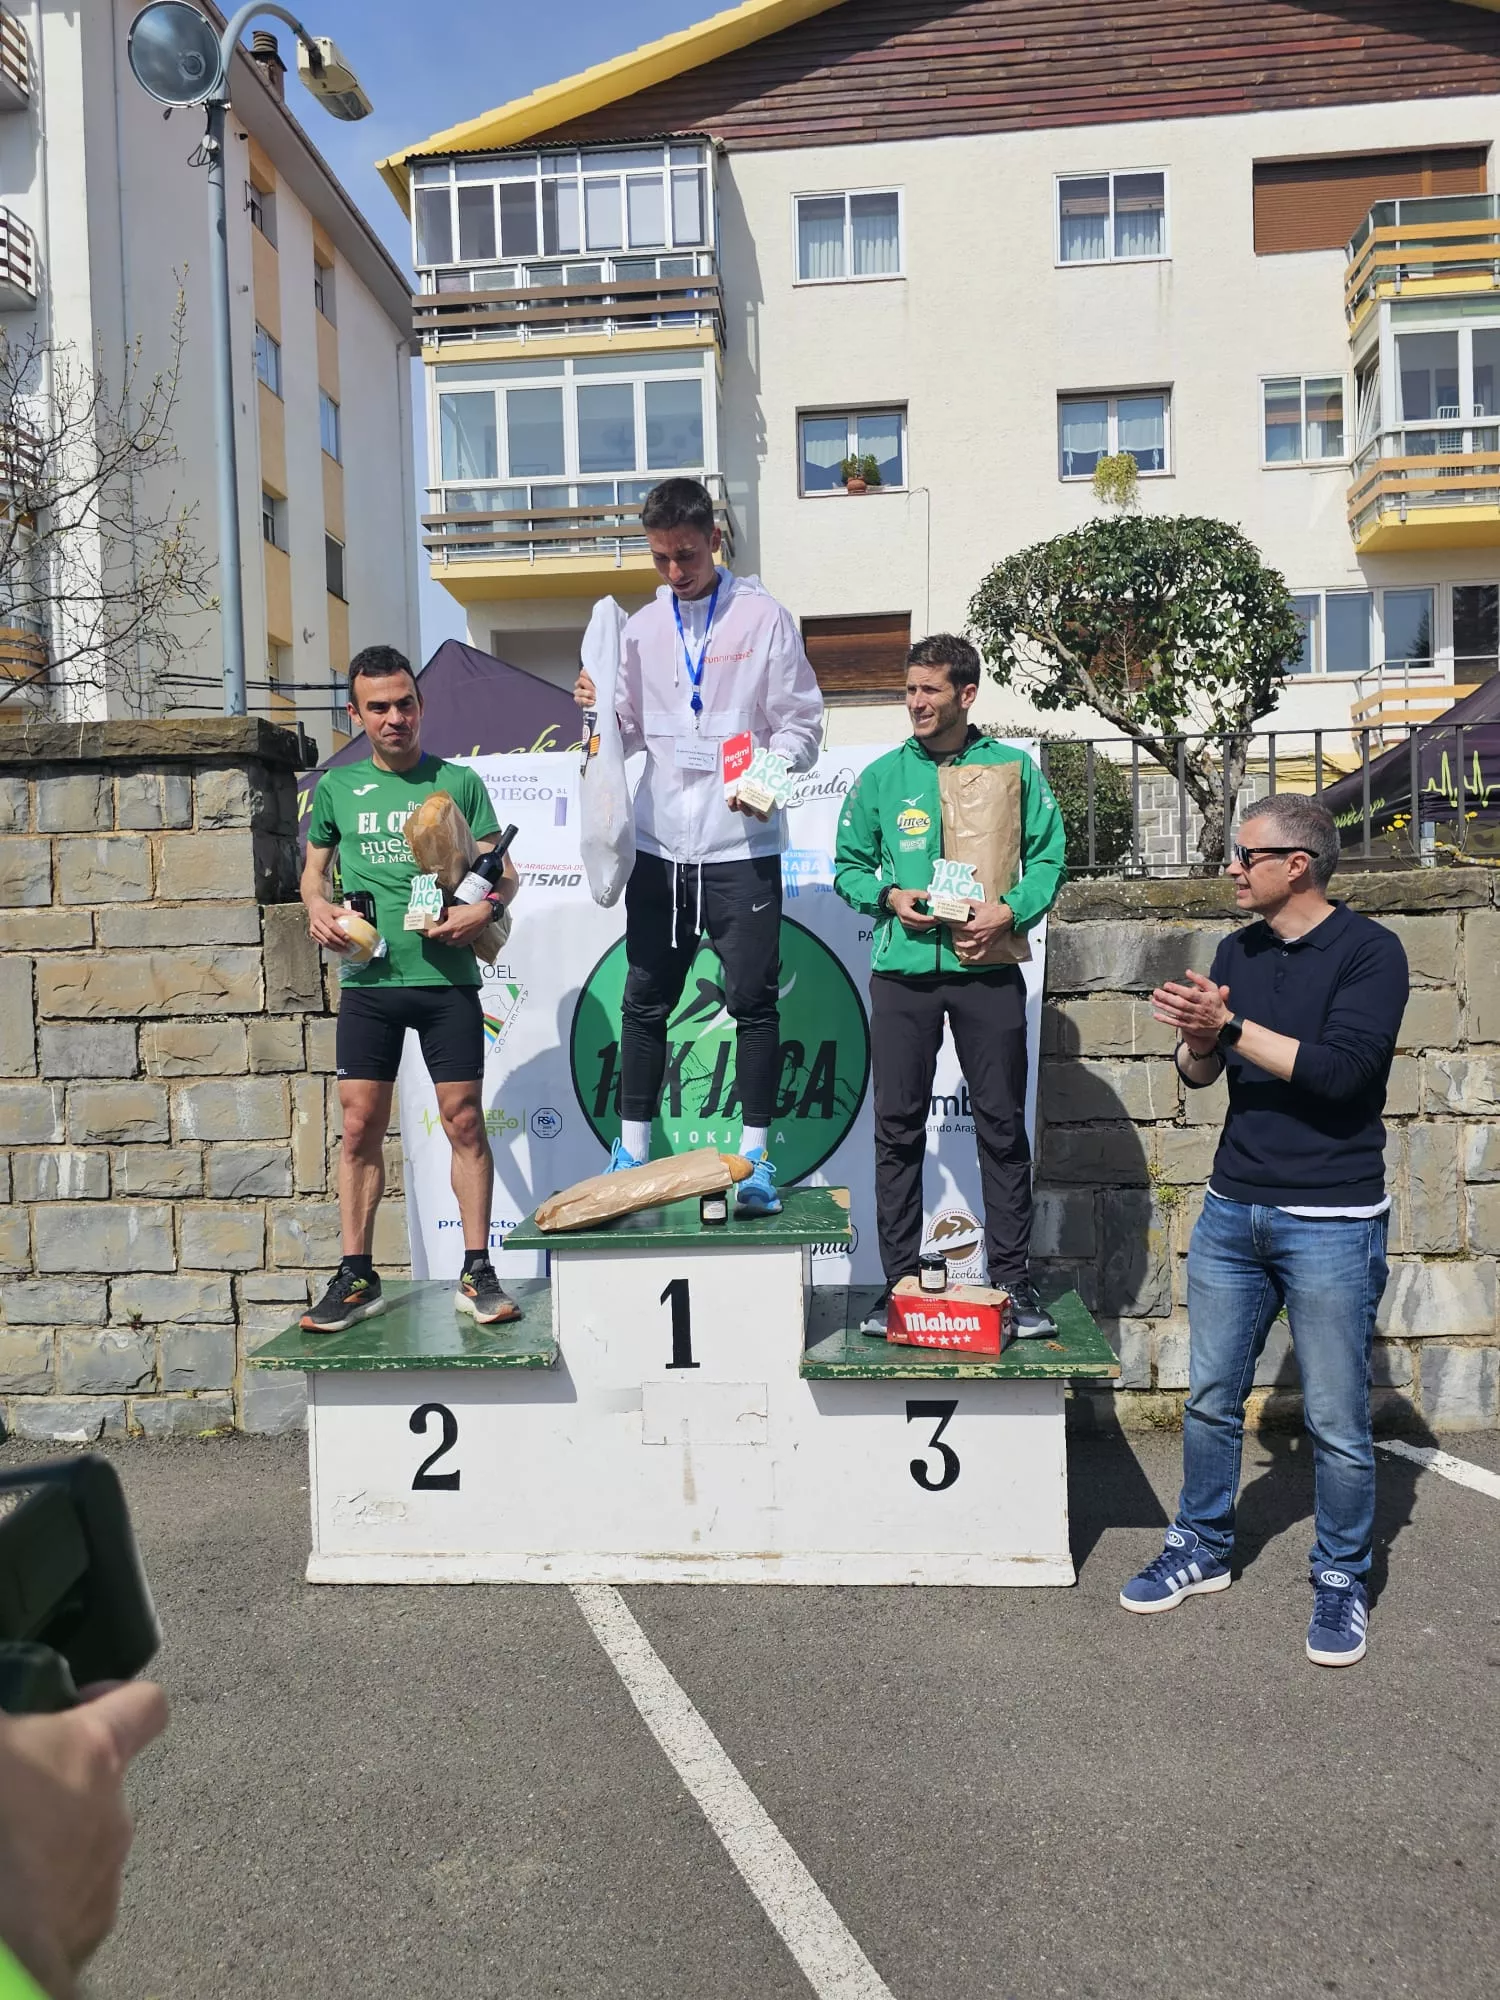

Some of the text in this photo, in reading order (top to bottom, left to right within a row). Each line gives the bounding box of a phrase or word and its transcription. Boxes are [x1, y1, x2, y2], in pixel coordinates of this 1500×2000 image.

[724, 747, 750, 765] Redmi
[357, 812, 380, 834] EL
[935, 860, 974, 881] 10K
[412, 877, 435, 892] 10K
[930, 877, 984, 901] JACA
[409, 890, 441, 908] JACA
[482, 964, 517, 979] OEL
[537, 1115, 556, 1125] RSA
[660, 1278, 700, 1369] 1
[903, 1311, 981, 1332] Mahou
[409, 1403, 461, 1491] 2
[906, 1400, 960, 1491] 3
